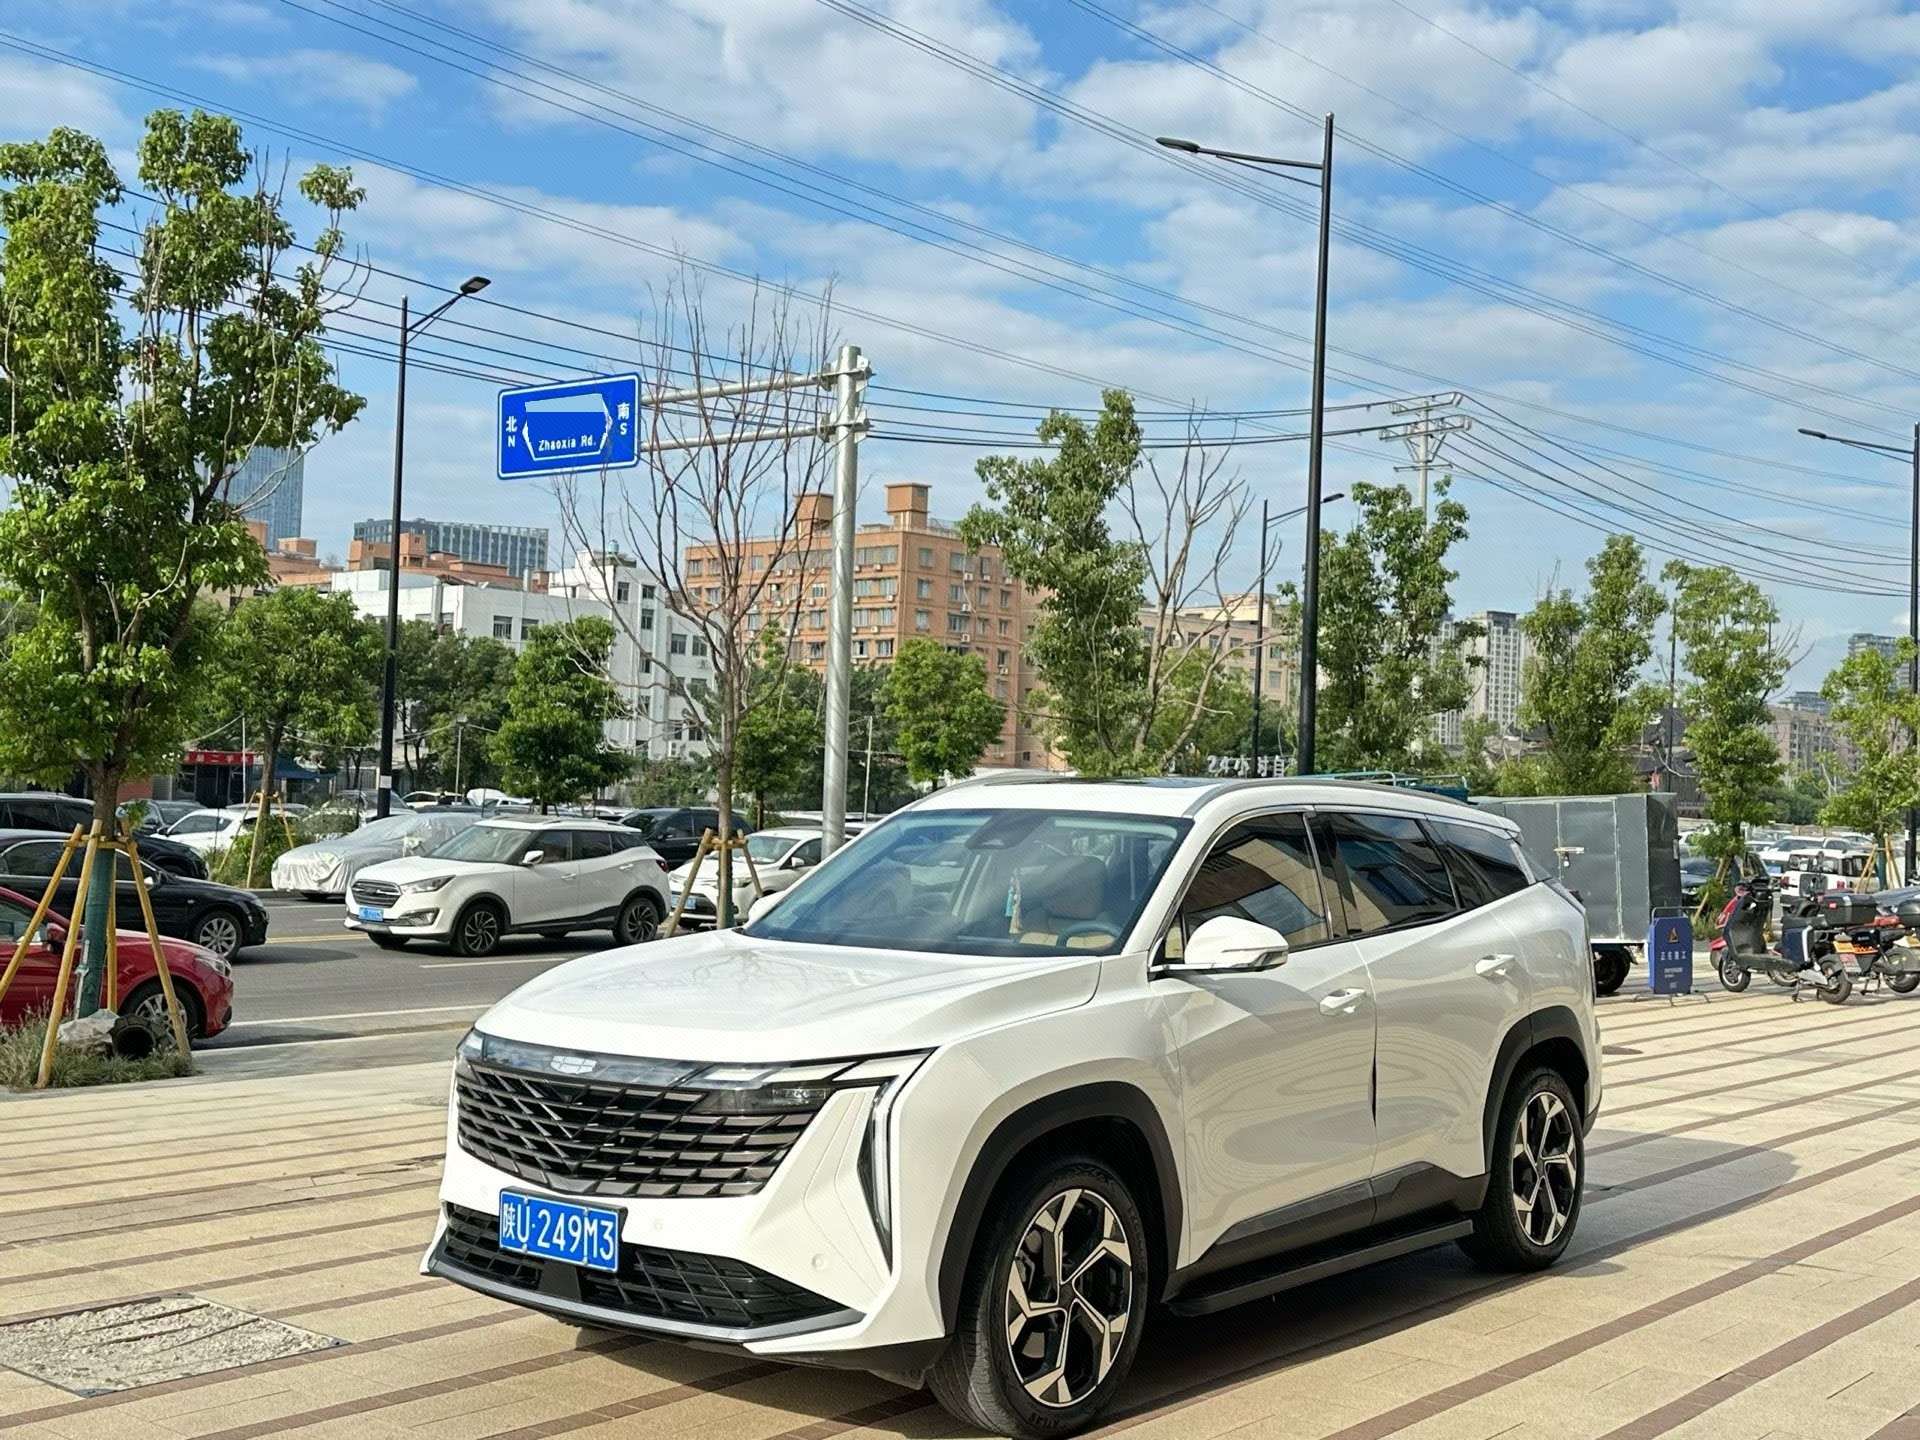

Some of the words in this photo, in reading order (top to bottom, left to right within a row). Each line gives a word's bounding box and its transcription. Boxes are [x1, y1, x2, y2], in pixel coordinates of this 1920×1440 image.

[617, 402, 630, 420] 南
[506, 416, 517, 433] 北
[620, 422, 628, 435] S
[508, 435, 515, 447] N
[538, 438, 576, 451] Zhaoxia
[581, 435, 597, 447] Rd.
